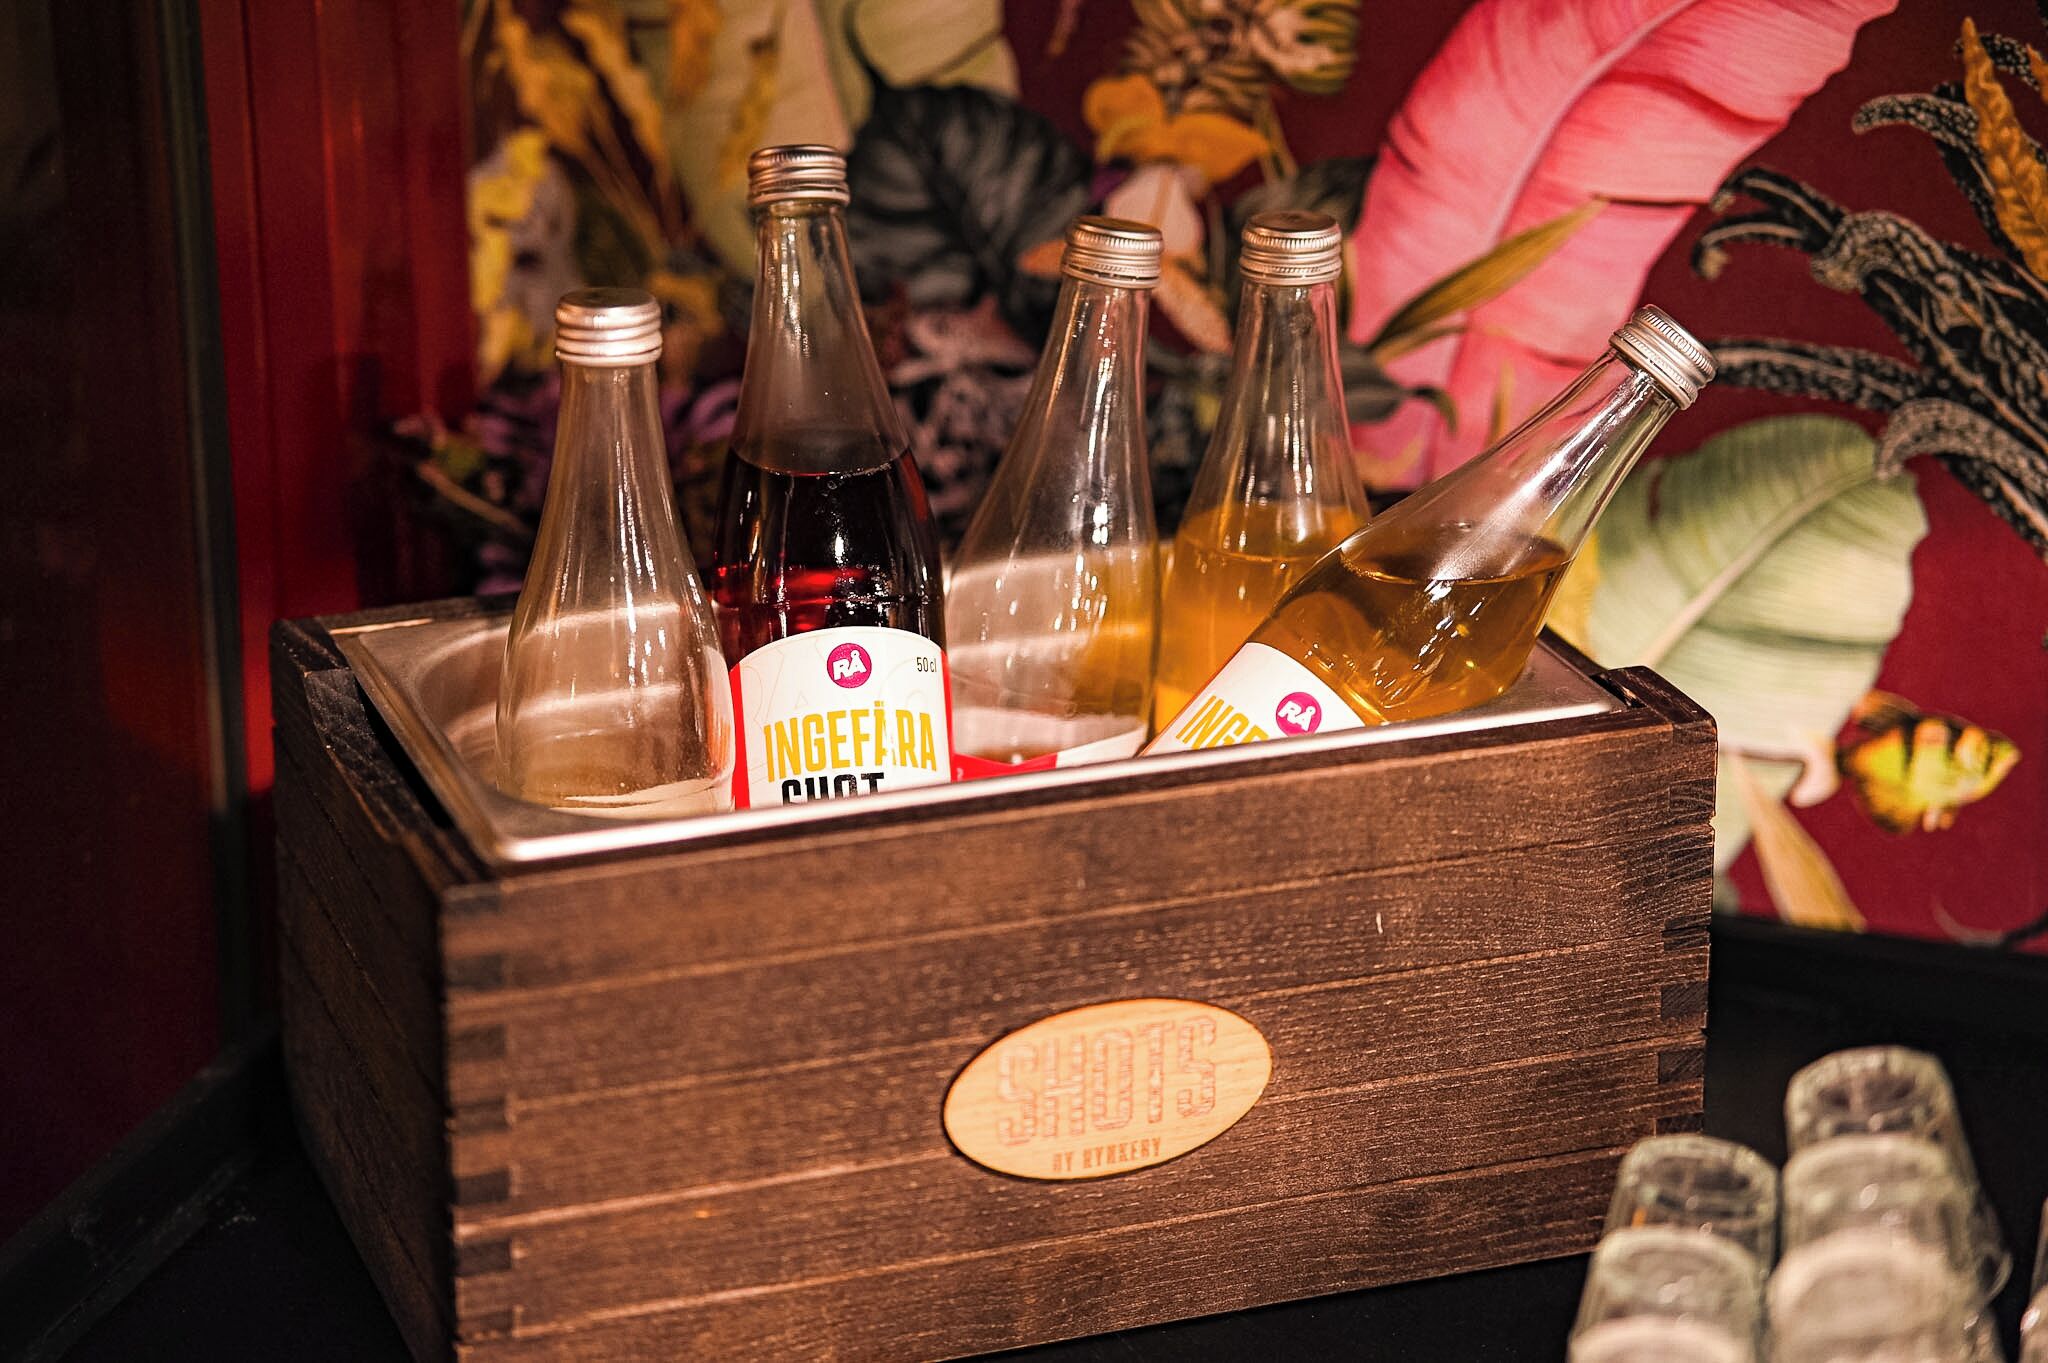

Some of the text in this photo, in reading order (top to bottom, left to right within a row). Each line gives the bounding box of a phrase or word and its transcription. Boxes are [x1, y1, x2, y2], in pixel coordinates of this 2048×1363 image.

[832, 649, 867, 681] RÅ
[1277, 700, 1316, 732] RÅ
[763, 700, 938, 783] INGEFÄRA
[997, 1014, 1218, 1147] SHOTS
[1053, 1151, 1073, 1173] BY
